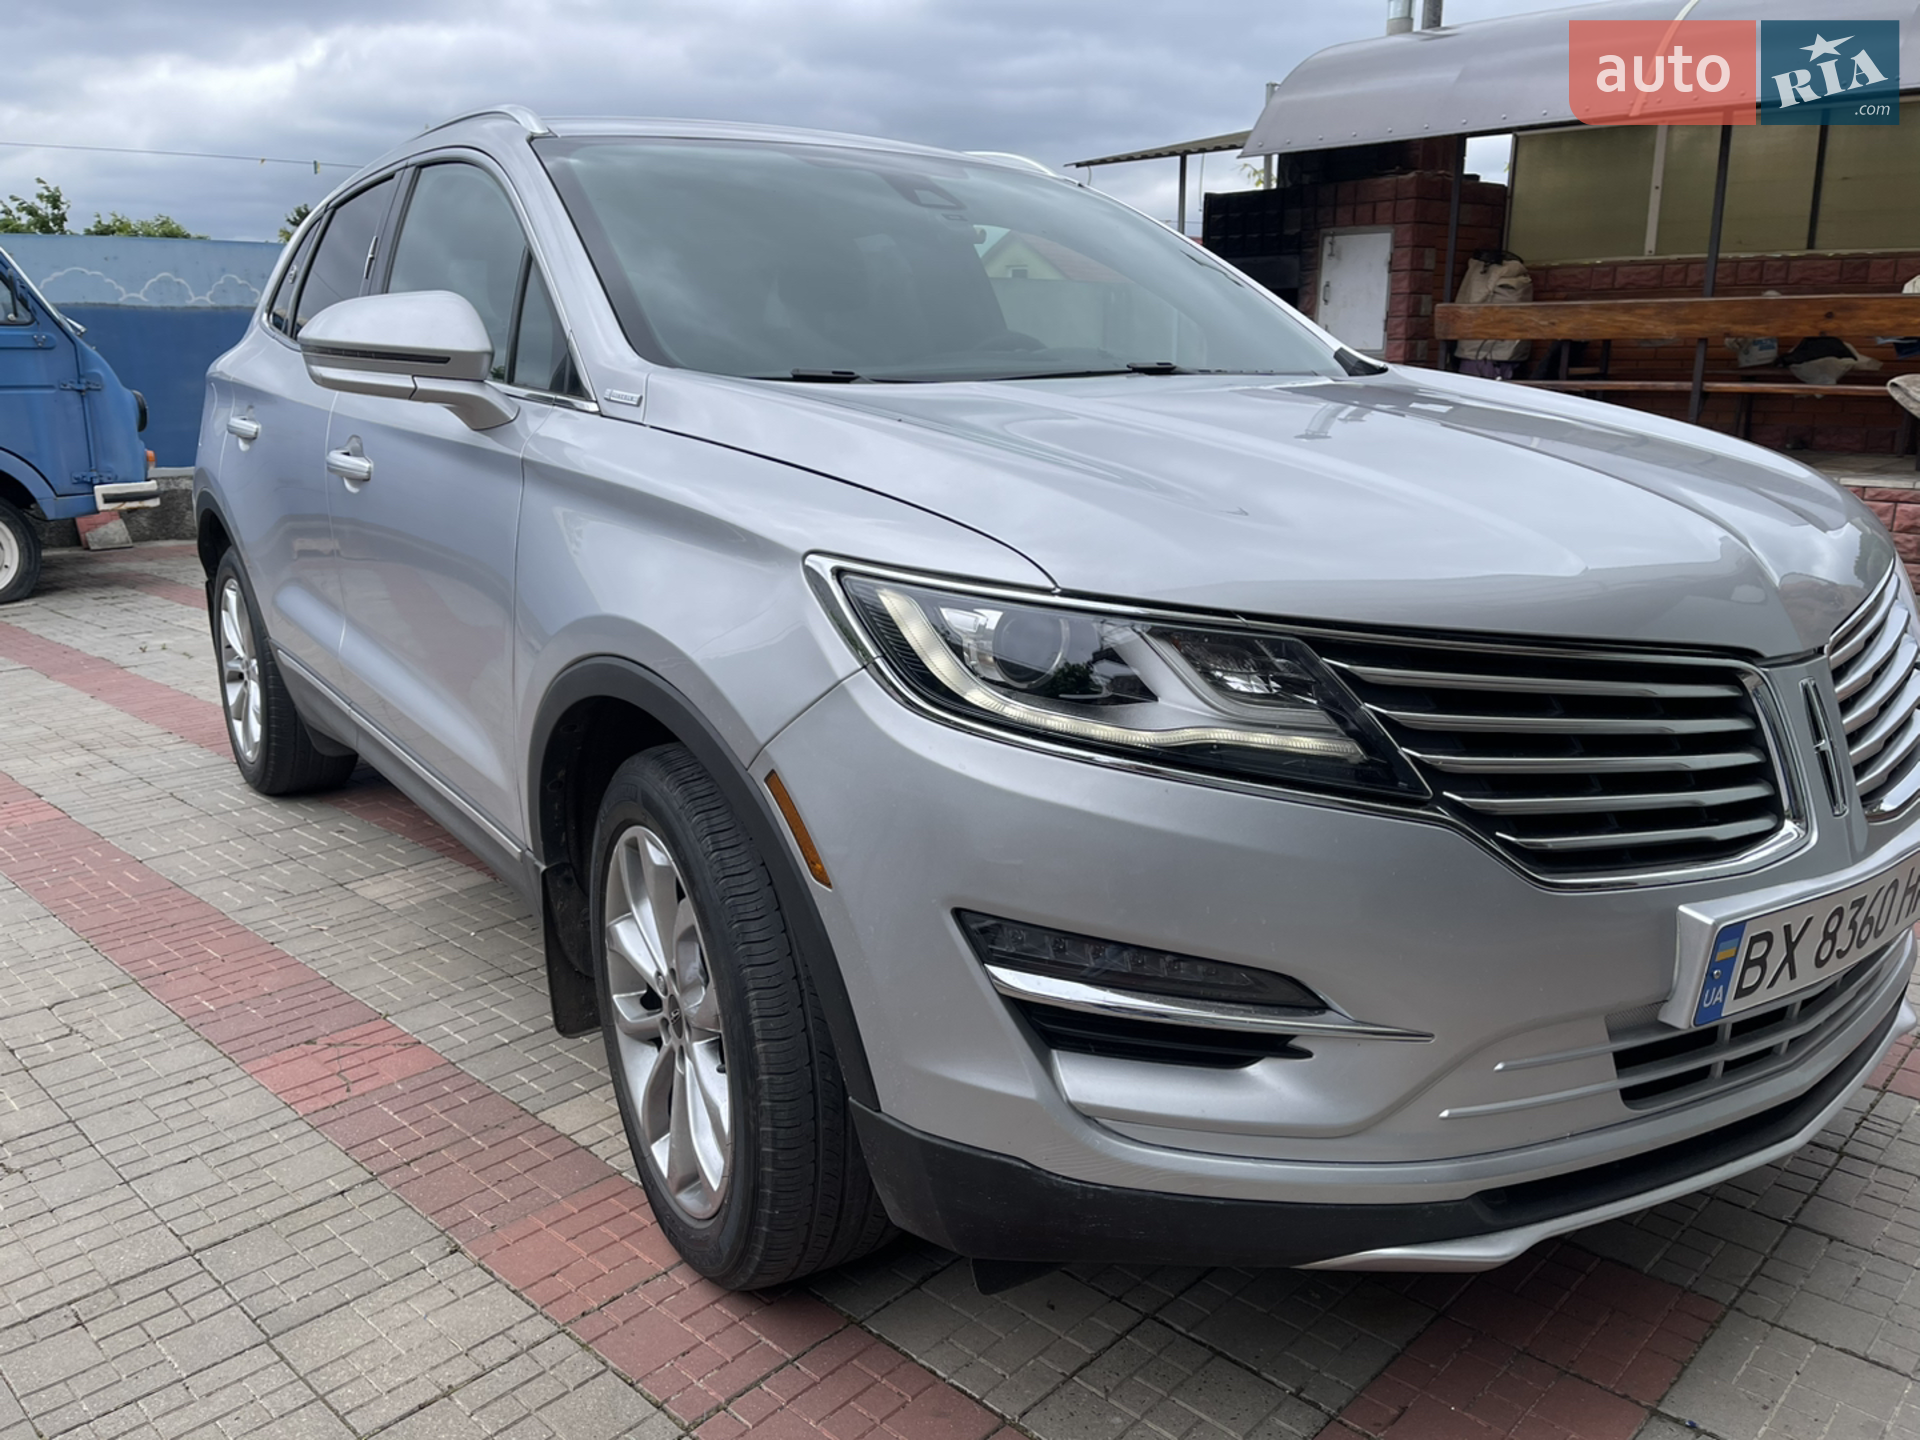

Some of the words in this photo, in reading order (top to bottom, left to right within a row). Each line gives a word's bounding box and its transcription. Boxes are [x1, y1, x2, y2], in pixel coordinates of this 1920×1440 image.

[1733, 916, 1814, 1001] BX
[1814, 878, 1899, 969] 8360
[1703, 984, 1724, 1008] UA
